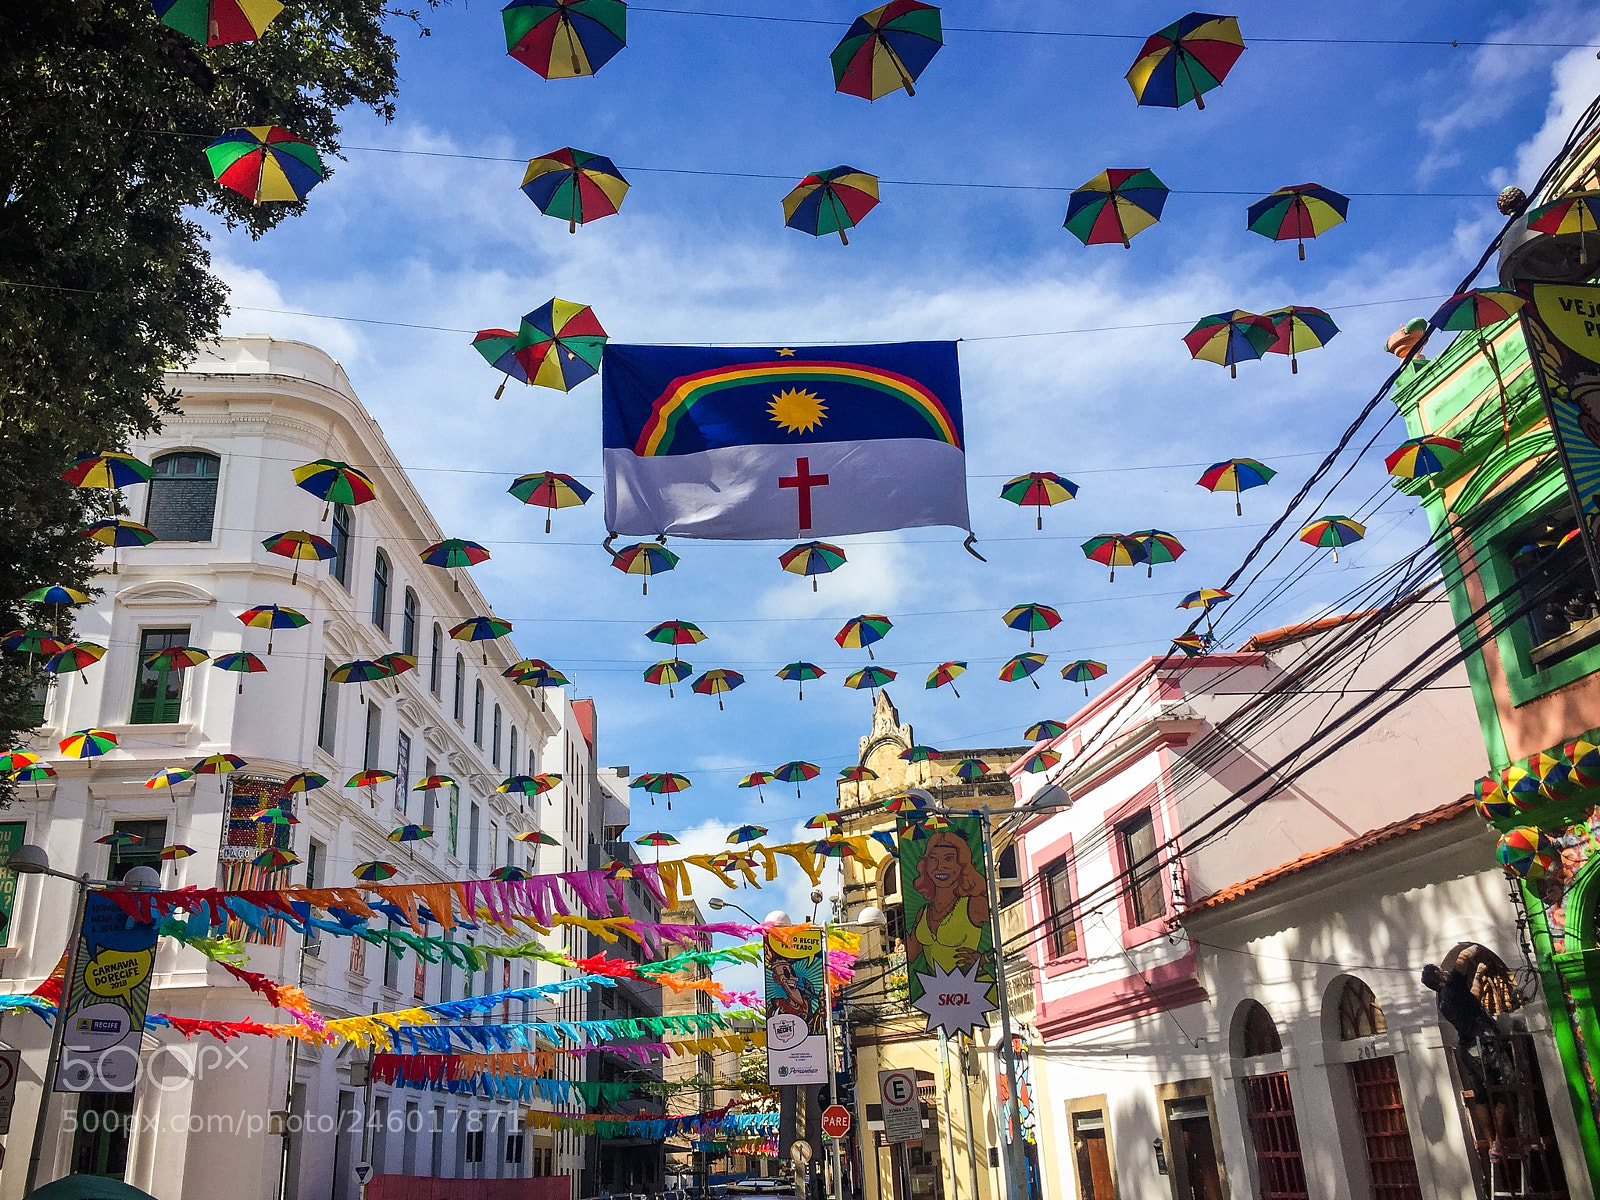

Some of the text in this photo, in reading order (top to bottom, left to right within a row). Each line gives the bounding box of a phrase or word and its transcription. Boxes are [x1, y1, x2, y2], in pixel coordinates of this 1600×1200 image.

[799, 937, 820, 945] RECIFE
[92, 958, 139, 977] CARNAVAL
[107, 967, 140, 983] RECIFE
[110, 979, 128, 990] 2018
[938, 992, 970, 1006] SKOL
[93, 1021, 119, 1029] RECIFE
[892, 1080, 906, 1100] E
[823, 1116, 848, 1127] PARE
